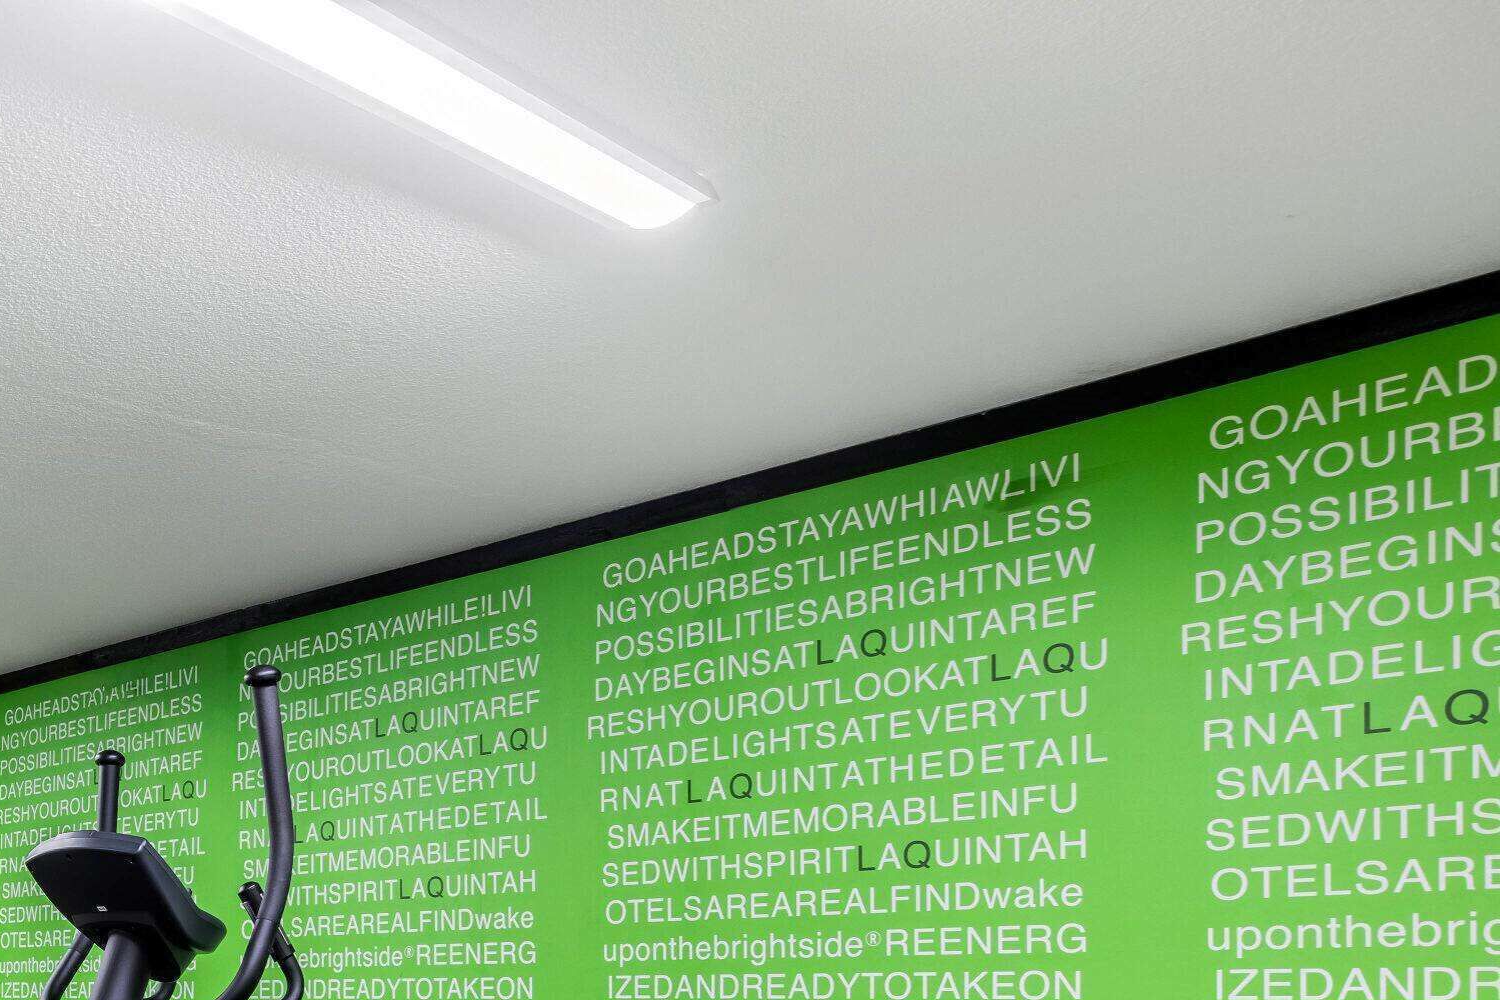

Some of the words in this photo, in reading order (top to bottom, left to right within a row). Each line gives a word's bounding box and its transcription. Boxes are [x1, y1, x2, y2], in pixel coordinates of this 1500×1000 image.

[1210, 355, 1498, 449] GOAHEAD
[597, 499, 1091, 627] NGYOURBESTLIFEENDLESS
[244, 585, 531, 677] GOAHEADSTAYAWHILE!LIVI
[596, 544, 1096, 664] POSSIBILITIESABRIGHTNEW
[1181, 576, 1500, 655] RESHYOUR
[240, 619, 537, 705] NOURBESTLIFEENDLESS
[596, 591, 1096, 701] DAYBEGINSATLAQUINTAREF
[1205, 630, 1500, 700] INTADELIG
[237, 690, 540, 761] DAEGINSATLAQUINTAREF
[588, 638, 1107, 739] RESHYOUROUTLOOKATLAQU
[231, 726, 547, 791] RESYOUROUTLOOKATLAQU
[601, 686, 1087, 774] INTADELIGHTSATEVERYTU
[601, 734, 1108, 812] RNATLAQUINTATHEDETAIL
[608, 783, 1077, 849] SMAKEITMEMORABLEINFU
[1205, 798, 1500, 851] SEDWITHS
[602, 829, 1087, 887] SEDWITHSPIRITLAQUINTAH
[605, 878, 1083, 924] OTELSAREAREALFINDwake
[608, 970, 1082, 1000] IZEDANDREADYTOTAKEON
[1216, 967, 1500, 1000] IZEDANDR
